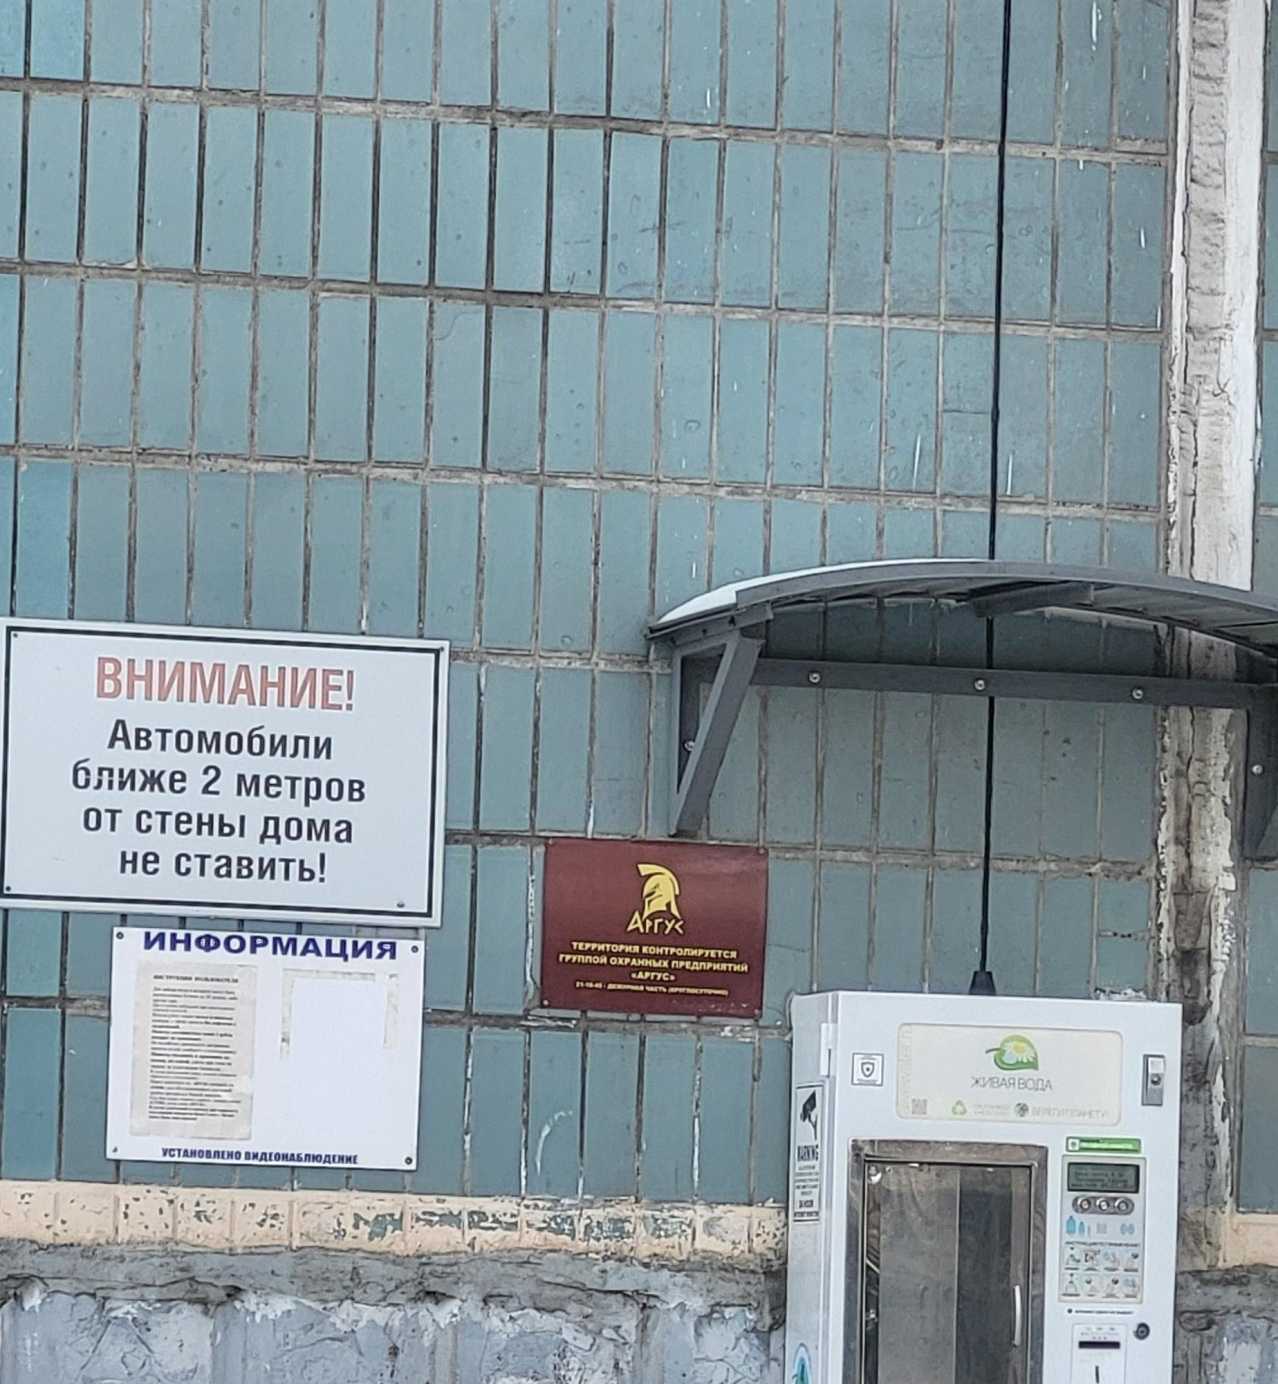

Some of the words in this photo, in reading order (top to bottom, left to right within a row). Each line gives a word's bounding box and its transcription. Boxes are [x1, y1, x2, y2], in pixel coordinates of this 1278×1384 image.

[97, 656, 355, 711] ВНИМАНИЕ!
[107, 719, 333, 760] Автомобили
[72, 759, 188, 794] ближе
[201, 765, 221, 796] 2
[236, 773, 366, 807] метров
[83, 807, 122, 832] от
[135, 811, 246, 839] стены
[259, 817, 353, 845] дома
[119, 850, 160, 876] не
[174, 853, 327, 883] ставить!
[143, 931, 398, 962] ИНФОРМАЦИЯ
[571, 941, 639, 954] ТЕРРИТОРИЯ
[642, 944, 737, 959] КОНТРОЛИРУЕТСЯ
[558, 953, 608, 964] ГРУППОЙ
[610, 957, 669, 968] ОХРАННЫХ
[671, 960, 749, 972] ПРЕДПРИЯТИЙ
[631, 971, 676, 981] «АРГУС»
[970, 1076, 1016, 1089] ЖИВАЯ
[1018, 1078, 1053, 1092] ВОДА
[162, 1147, 241, 1160] УСТАНОВЛЕНО
[244, 1151, 359, 1165] ВИДЕОНАБЛЮДЕНИЕ
